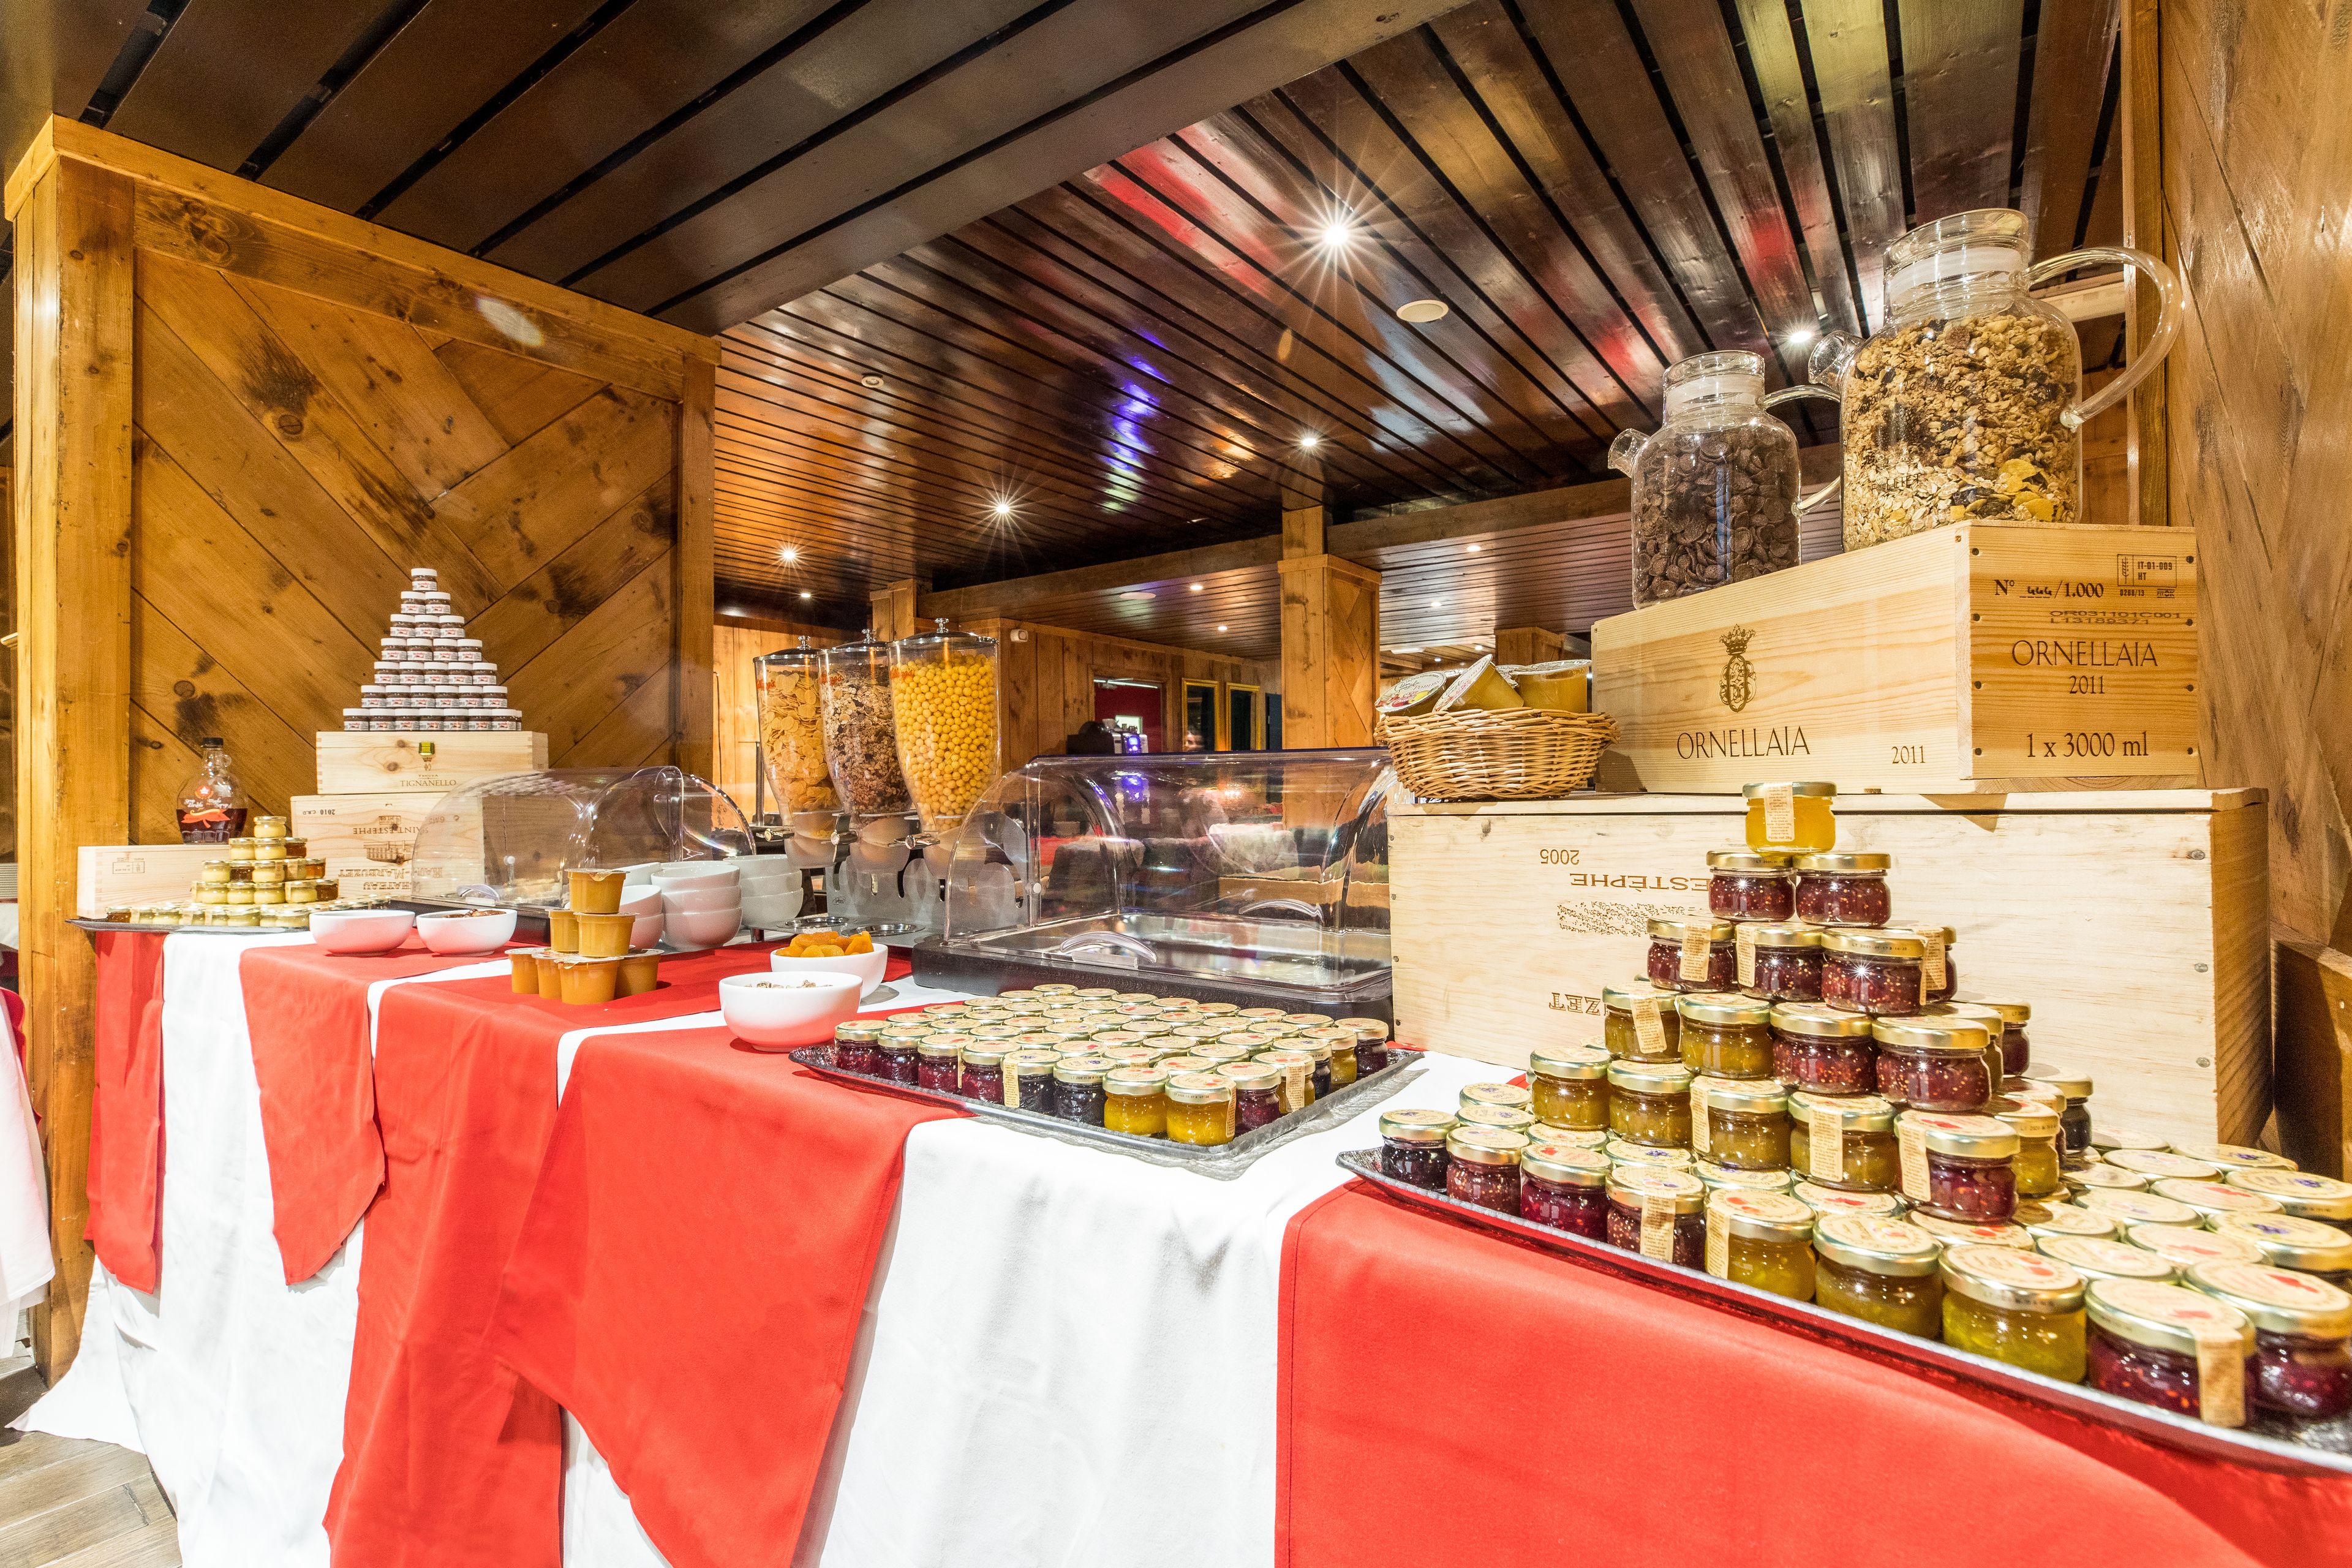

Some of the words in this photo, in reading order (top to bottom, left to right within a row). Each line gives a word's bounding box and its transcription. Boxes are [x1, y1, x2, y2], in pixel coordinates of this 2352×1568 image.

[2138, 561, 2173, 570] IT-01-009
[2138, 571, 2147, 581] HT
[2011, 639, 2158, 666] ORNELLAIA
[2069, 675, 2105, 694] 2011
[1676, 726, 1811, 760] ORNELLAIA
[2026, 733, 2036, 758] 1
[2043, 741, 2057, 758] x
[2064, 733, 2115, 757] 3000
[2122, 730, 2149, 756] ml
[1891, 745, 1927, 764] 2011
[1539, 848, 1580, 865] 2005
